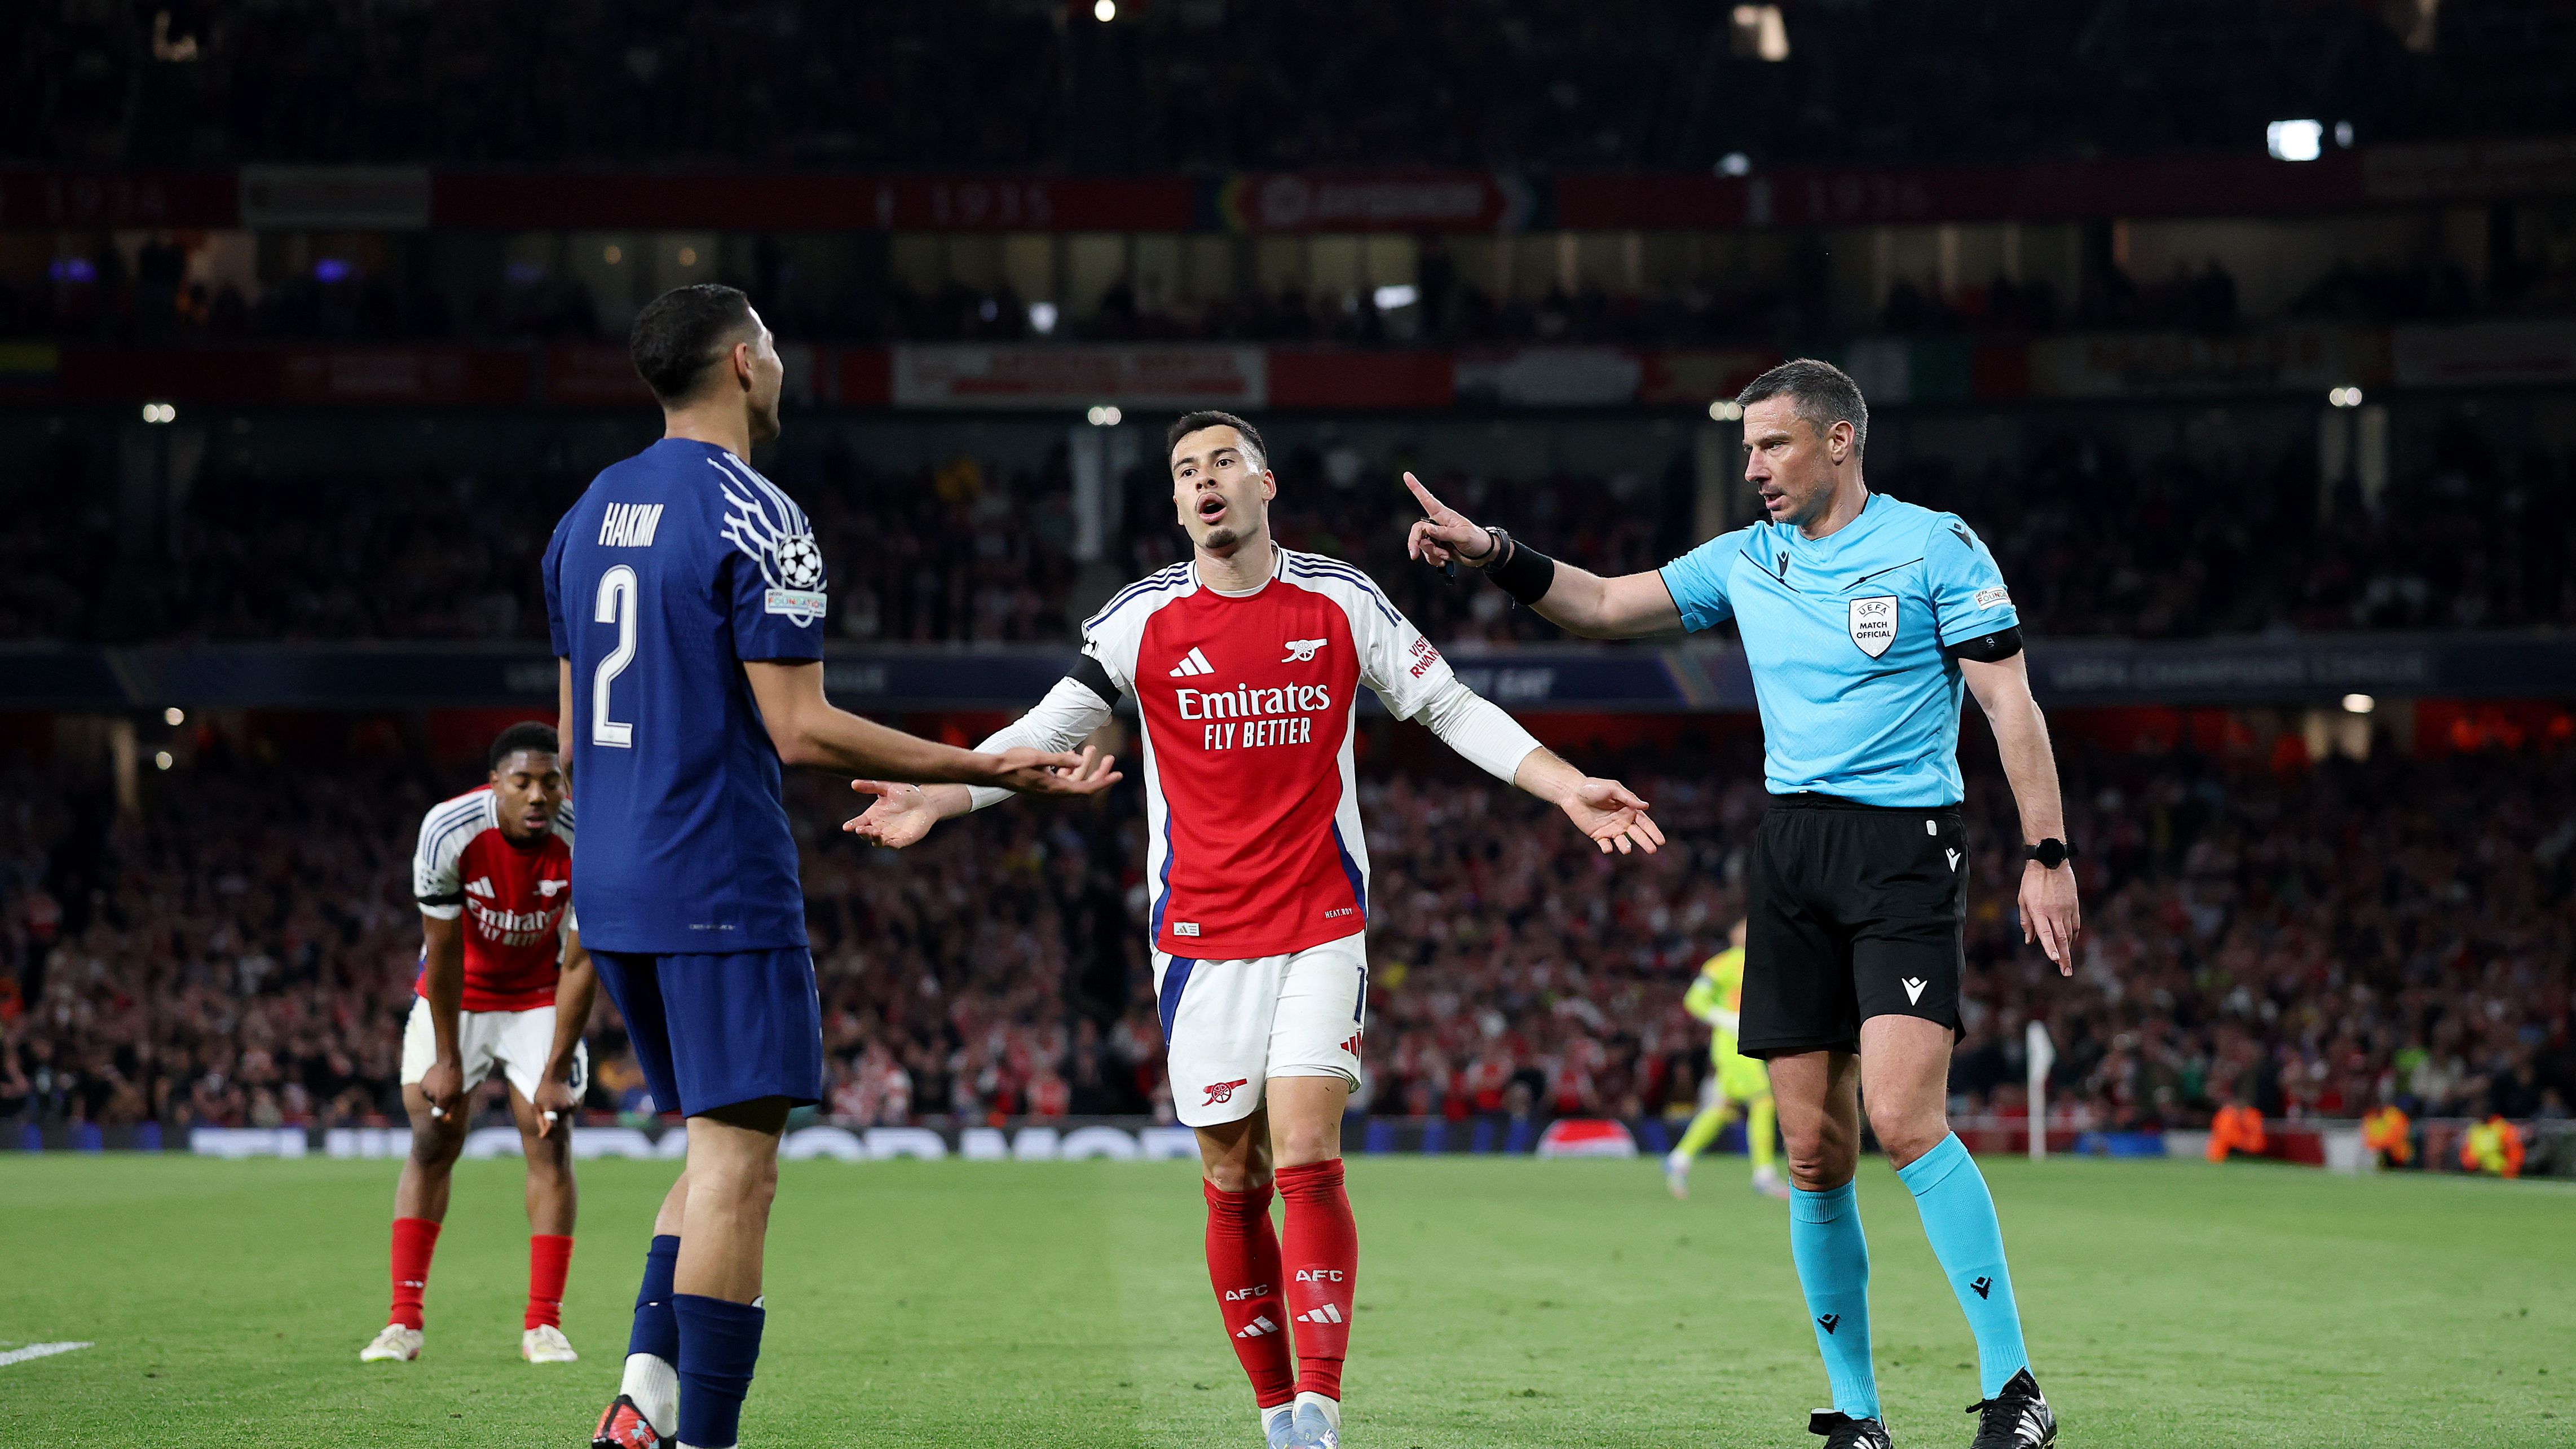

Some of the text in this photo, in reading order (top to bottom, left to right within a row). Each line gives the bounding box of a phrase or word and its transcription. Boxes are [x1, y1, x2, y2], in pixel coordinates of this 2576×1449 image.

[1859, 604, 1886, 615] UEFA
[1856, 630, 1891, 639] OFFICIAL
[593, 564, 637, 748] 2
[1175, 681, 1330, 719] Emirates
[1205, 717, 1311, 750] FLY BETTER
[1325, 908, 1352, 918] HEAT.RDY
[1296, 1270, 1343, 1282] AFC
[1225, 1284, 1268, 1301] AFC
